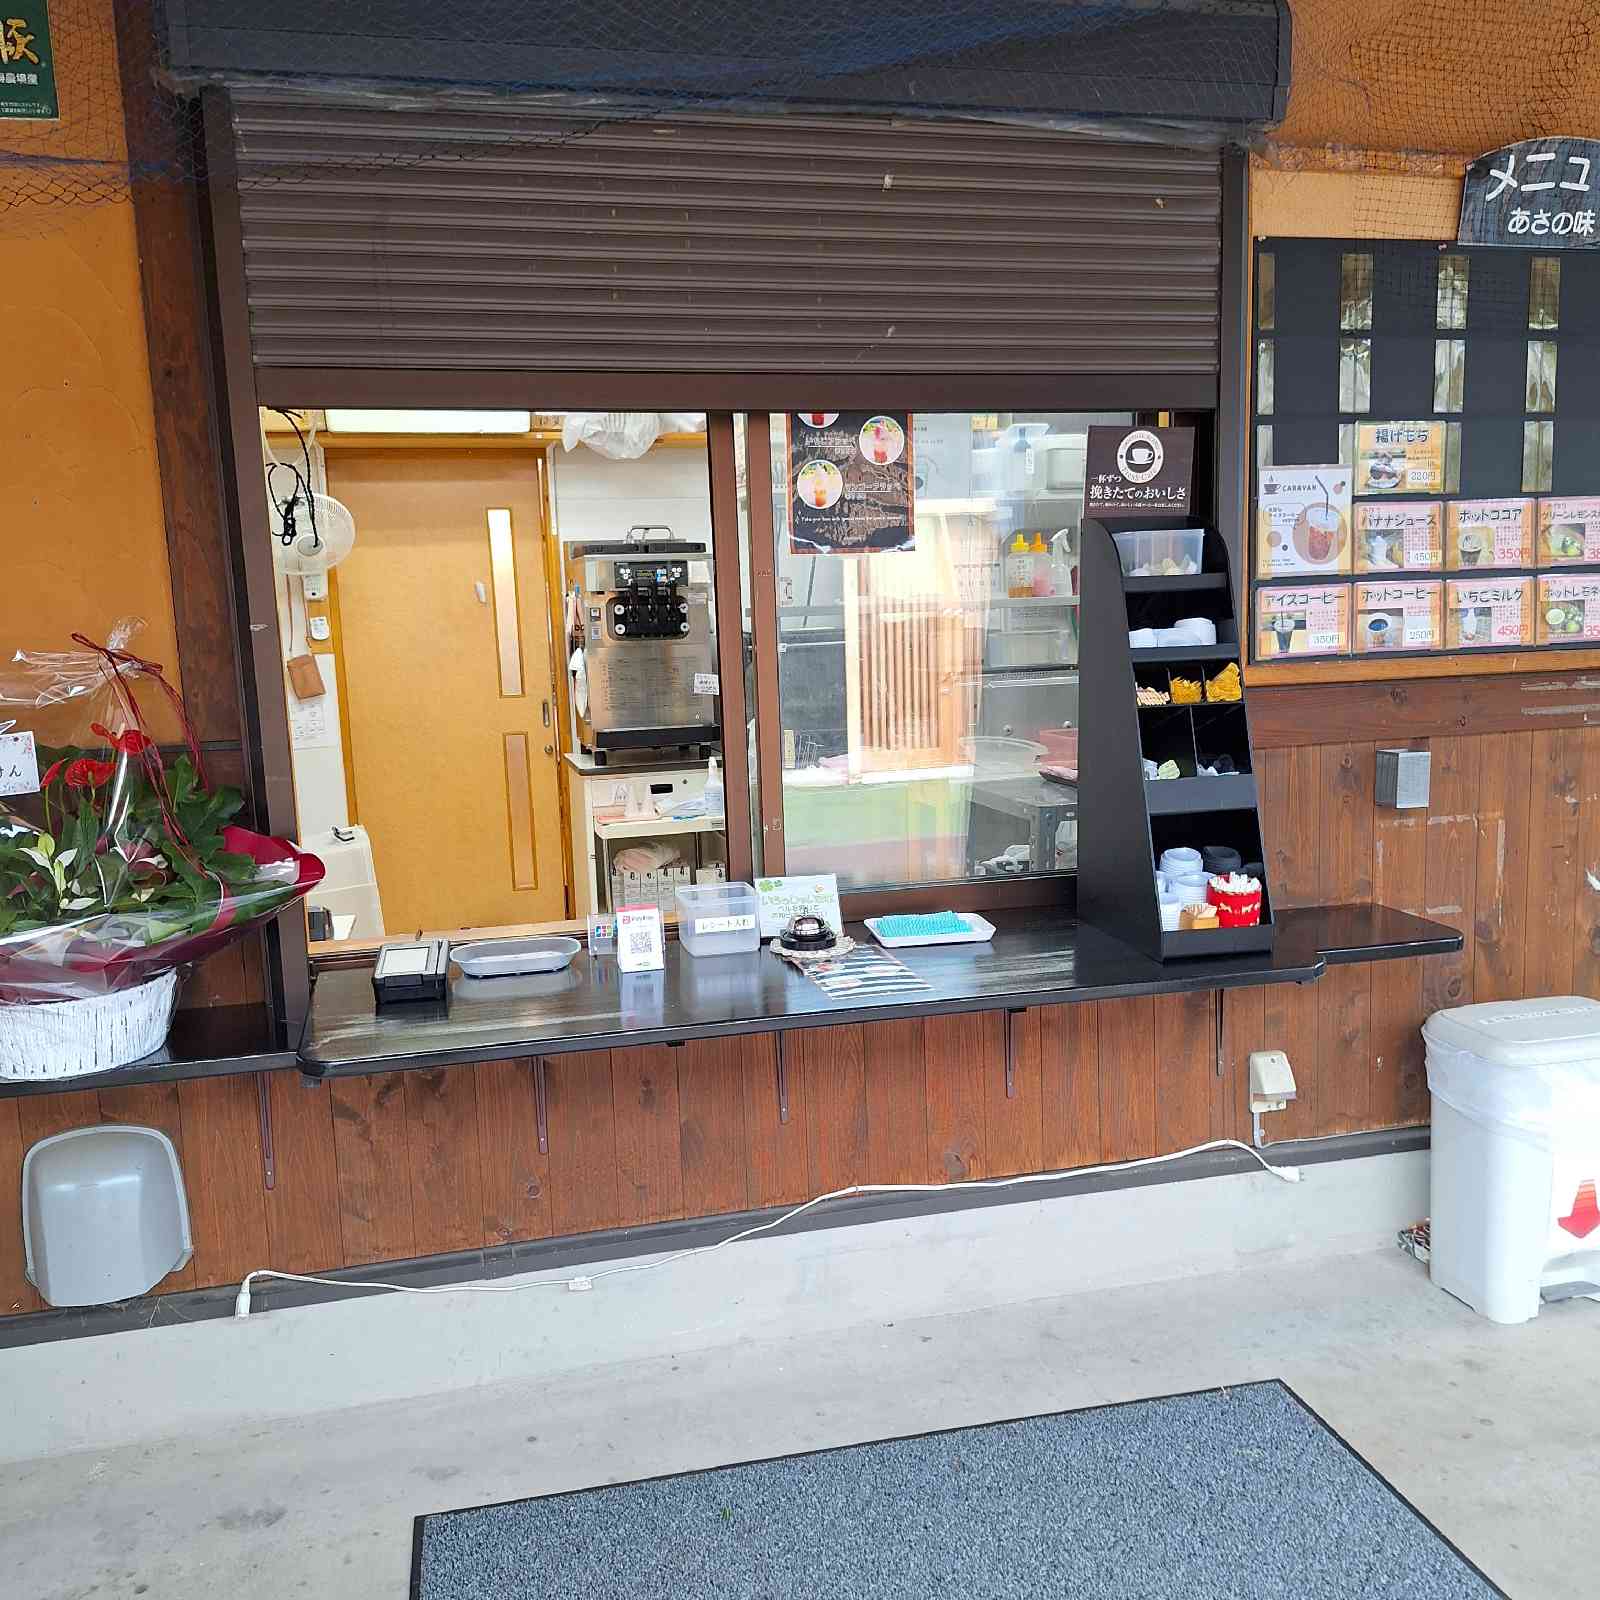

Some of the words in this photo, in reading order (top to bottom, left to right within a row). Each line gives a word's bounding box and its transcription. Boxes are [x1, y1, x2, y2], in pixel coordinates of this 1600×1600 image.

[1507, 206, 1596, 237] あさの味
[1375, 428, 1429, 444] 揚げもち
[1089, 485, 1186, 500] 挽きたてのおいしさ
[1281, 484, 1318, 493] CARAVAN
[1360, 511, 1437, 528] バナナジュース
[1458, 508, 1522, 523] ホットココア
[1542, 509, 1600, 521] グリーンレモンス
[1264, 591, 1345, 607] アイスコーヒー
[1361, 586, 1438, 602] ホットコーヒー
[1457, 588, 1523, 604] いちごミルク
[1543, 585, 1600, 599] ホットレモネ
[702, 917, 749, 931] レシート入れ
